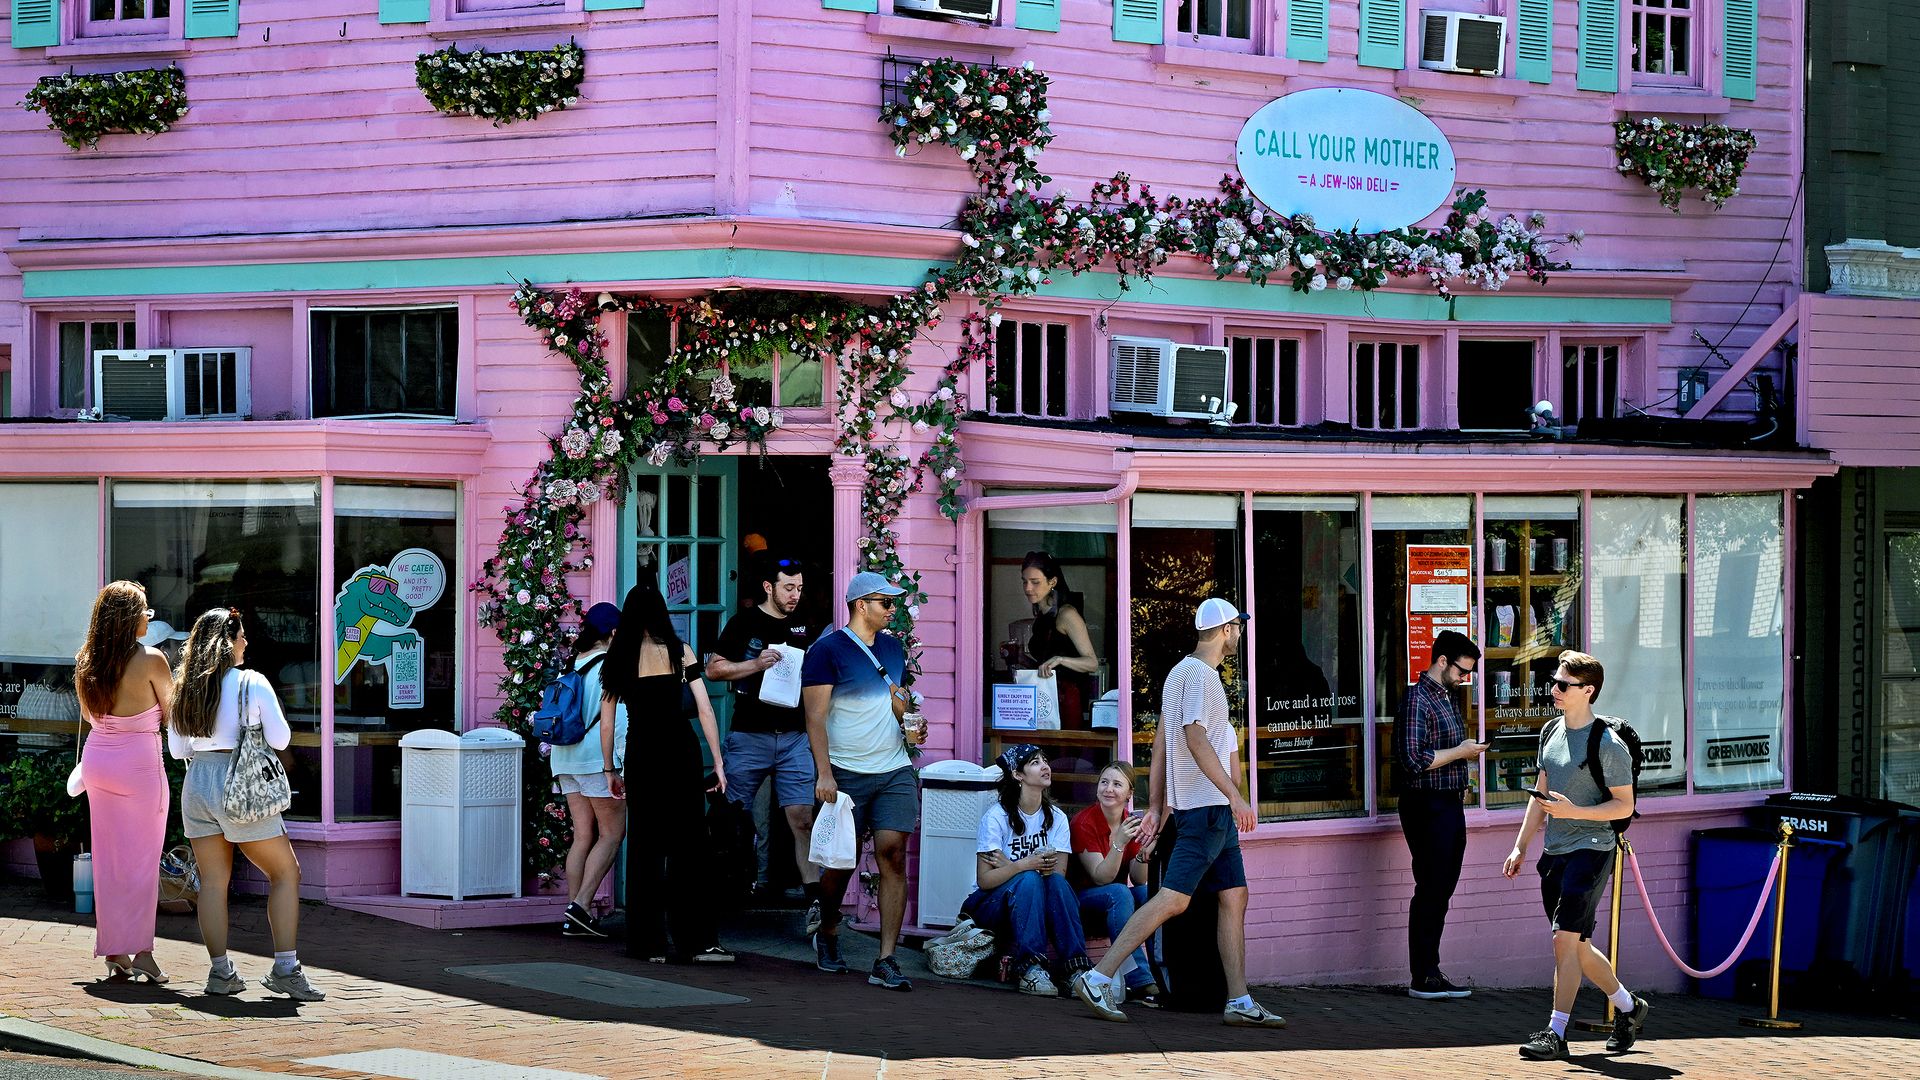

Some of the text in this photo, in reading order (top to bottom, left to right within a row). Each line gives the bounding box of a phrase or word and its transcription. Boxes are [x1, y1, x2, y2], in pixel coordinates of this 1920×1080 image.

[1255, 129, 1439, 170] CALL YOUR MOTHER
[1310, 174, 1388, 192] A JEW-ISH DELI
[6, 683, 20, 692] are
[24, 679, 50, 692] love's
[1495, 684, 1498, 697] I
[1501, 686, 1521, 697] must
[1524, 683, 1542, 696] have
[1267, 692, 1356, 711] Love and a red rose
[1495, 705, 1522, 721] always
[1525, 703, 1540, 717] and
[1267, 714, 1332, 733] cannot be hid.
[1500, 725, 1515, 733] Claude
[1517, 724, 1530, 732] Monet
[1274, 738, 1293, 748] Thomas
[1294, 736, 1313, 748] Holcroft
[1708, 742, 1769, 760] GREENWORKS
[1781, 816, 1828, 832] TRASH
[1008, 830, 1047, 853] ELLIOTT
